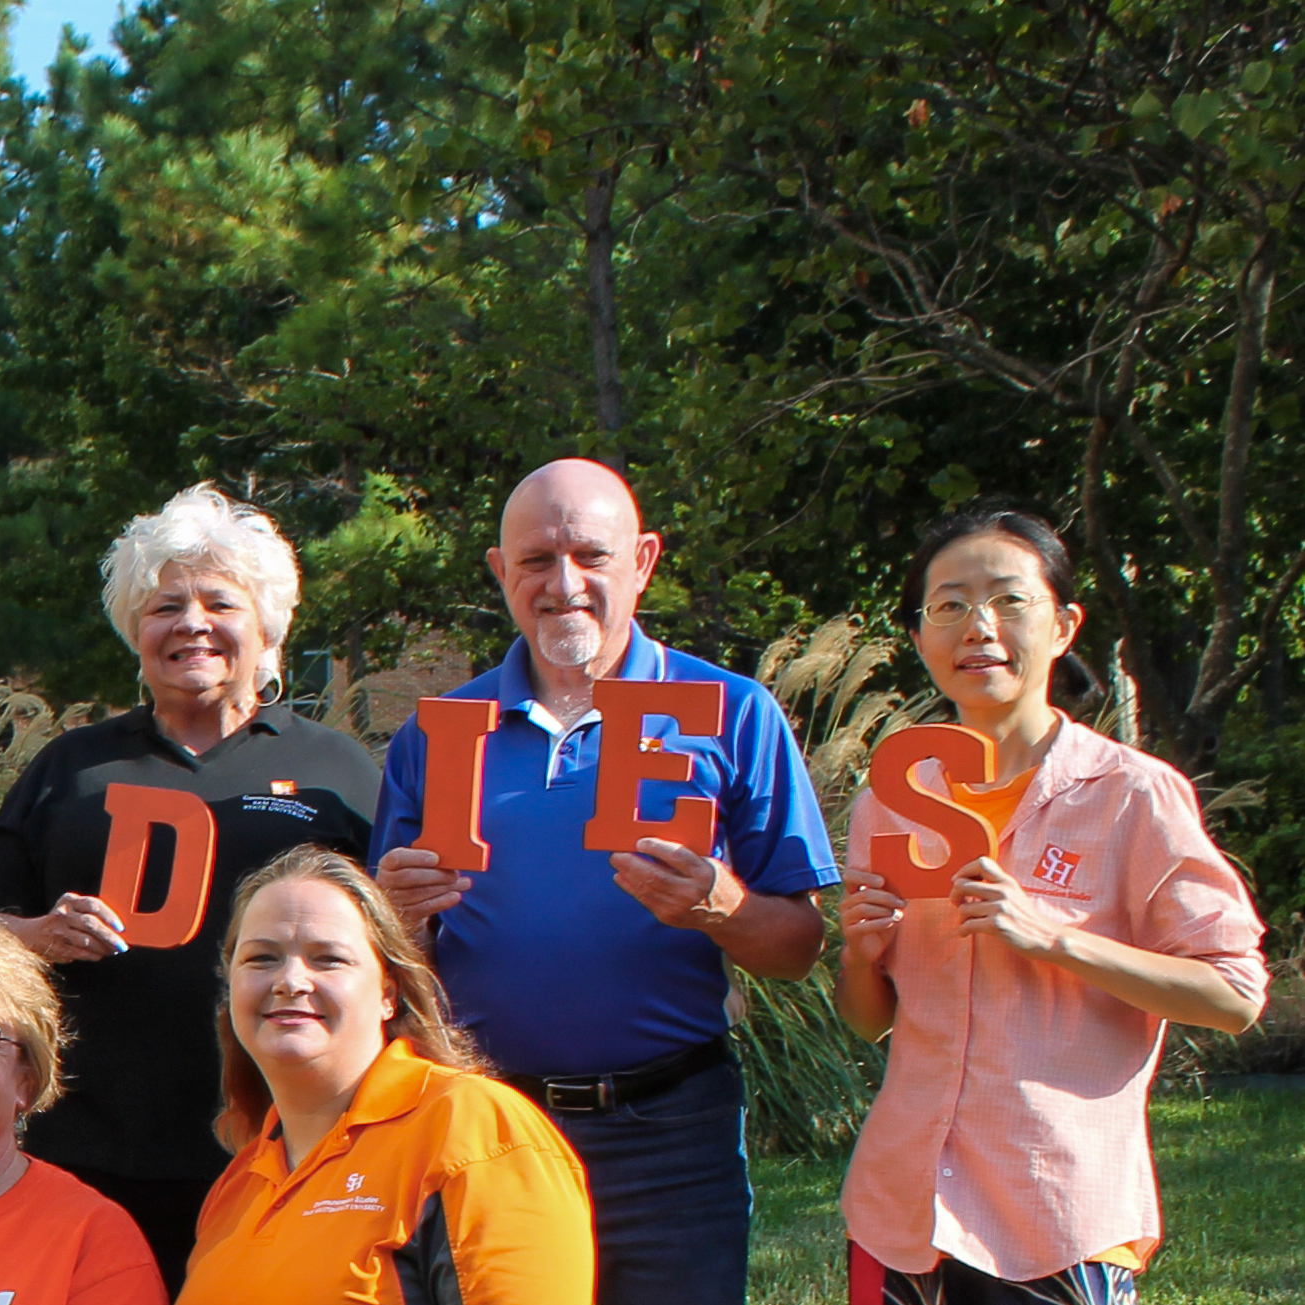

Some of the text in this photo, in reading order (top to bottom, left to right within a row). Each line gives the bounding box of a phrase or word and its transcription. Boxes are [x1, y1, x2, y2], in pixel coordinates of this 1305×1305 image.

[97, 783, 218, 949] D
[411, 697, 498, 872] I
[584, 678, 724, 856] E
[870, 723, 999, 900] S
[1042, 847, 1075, 886] SH
